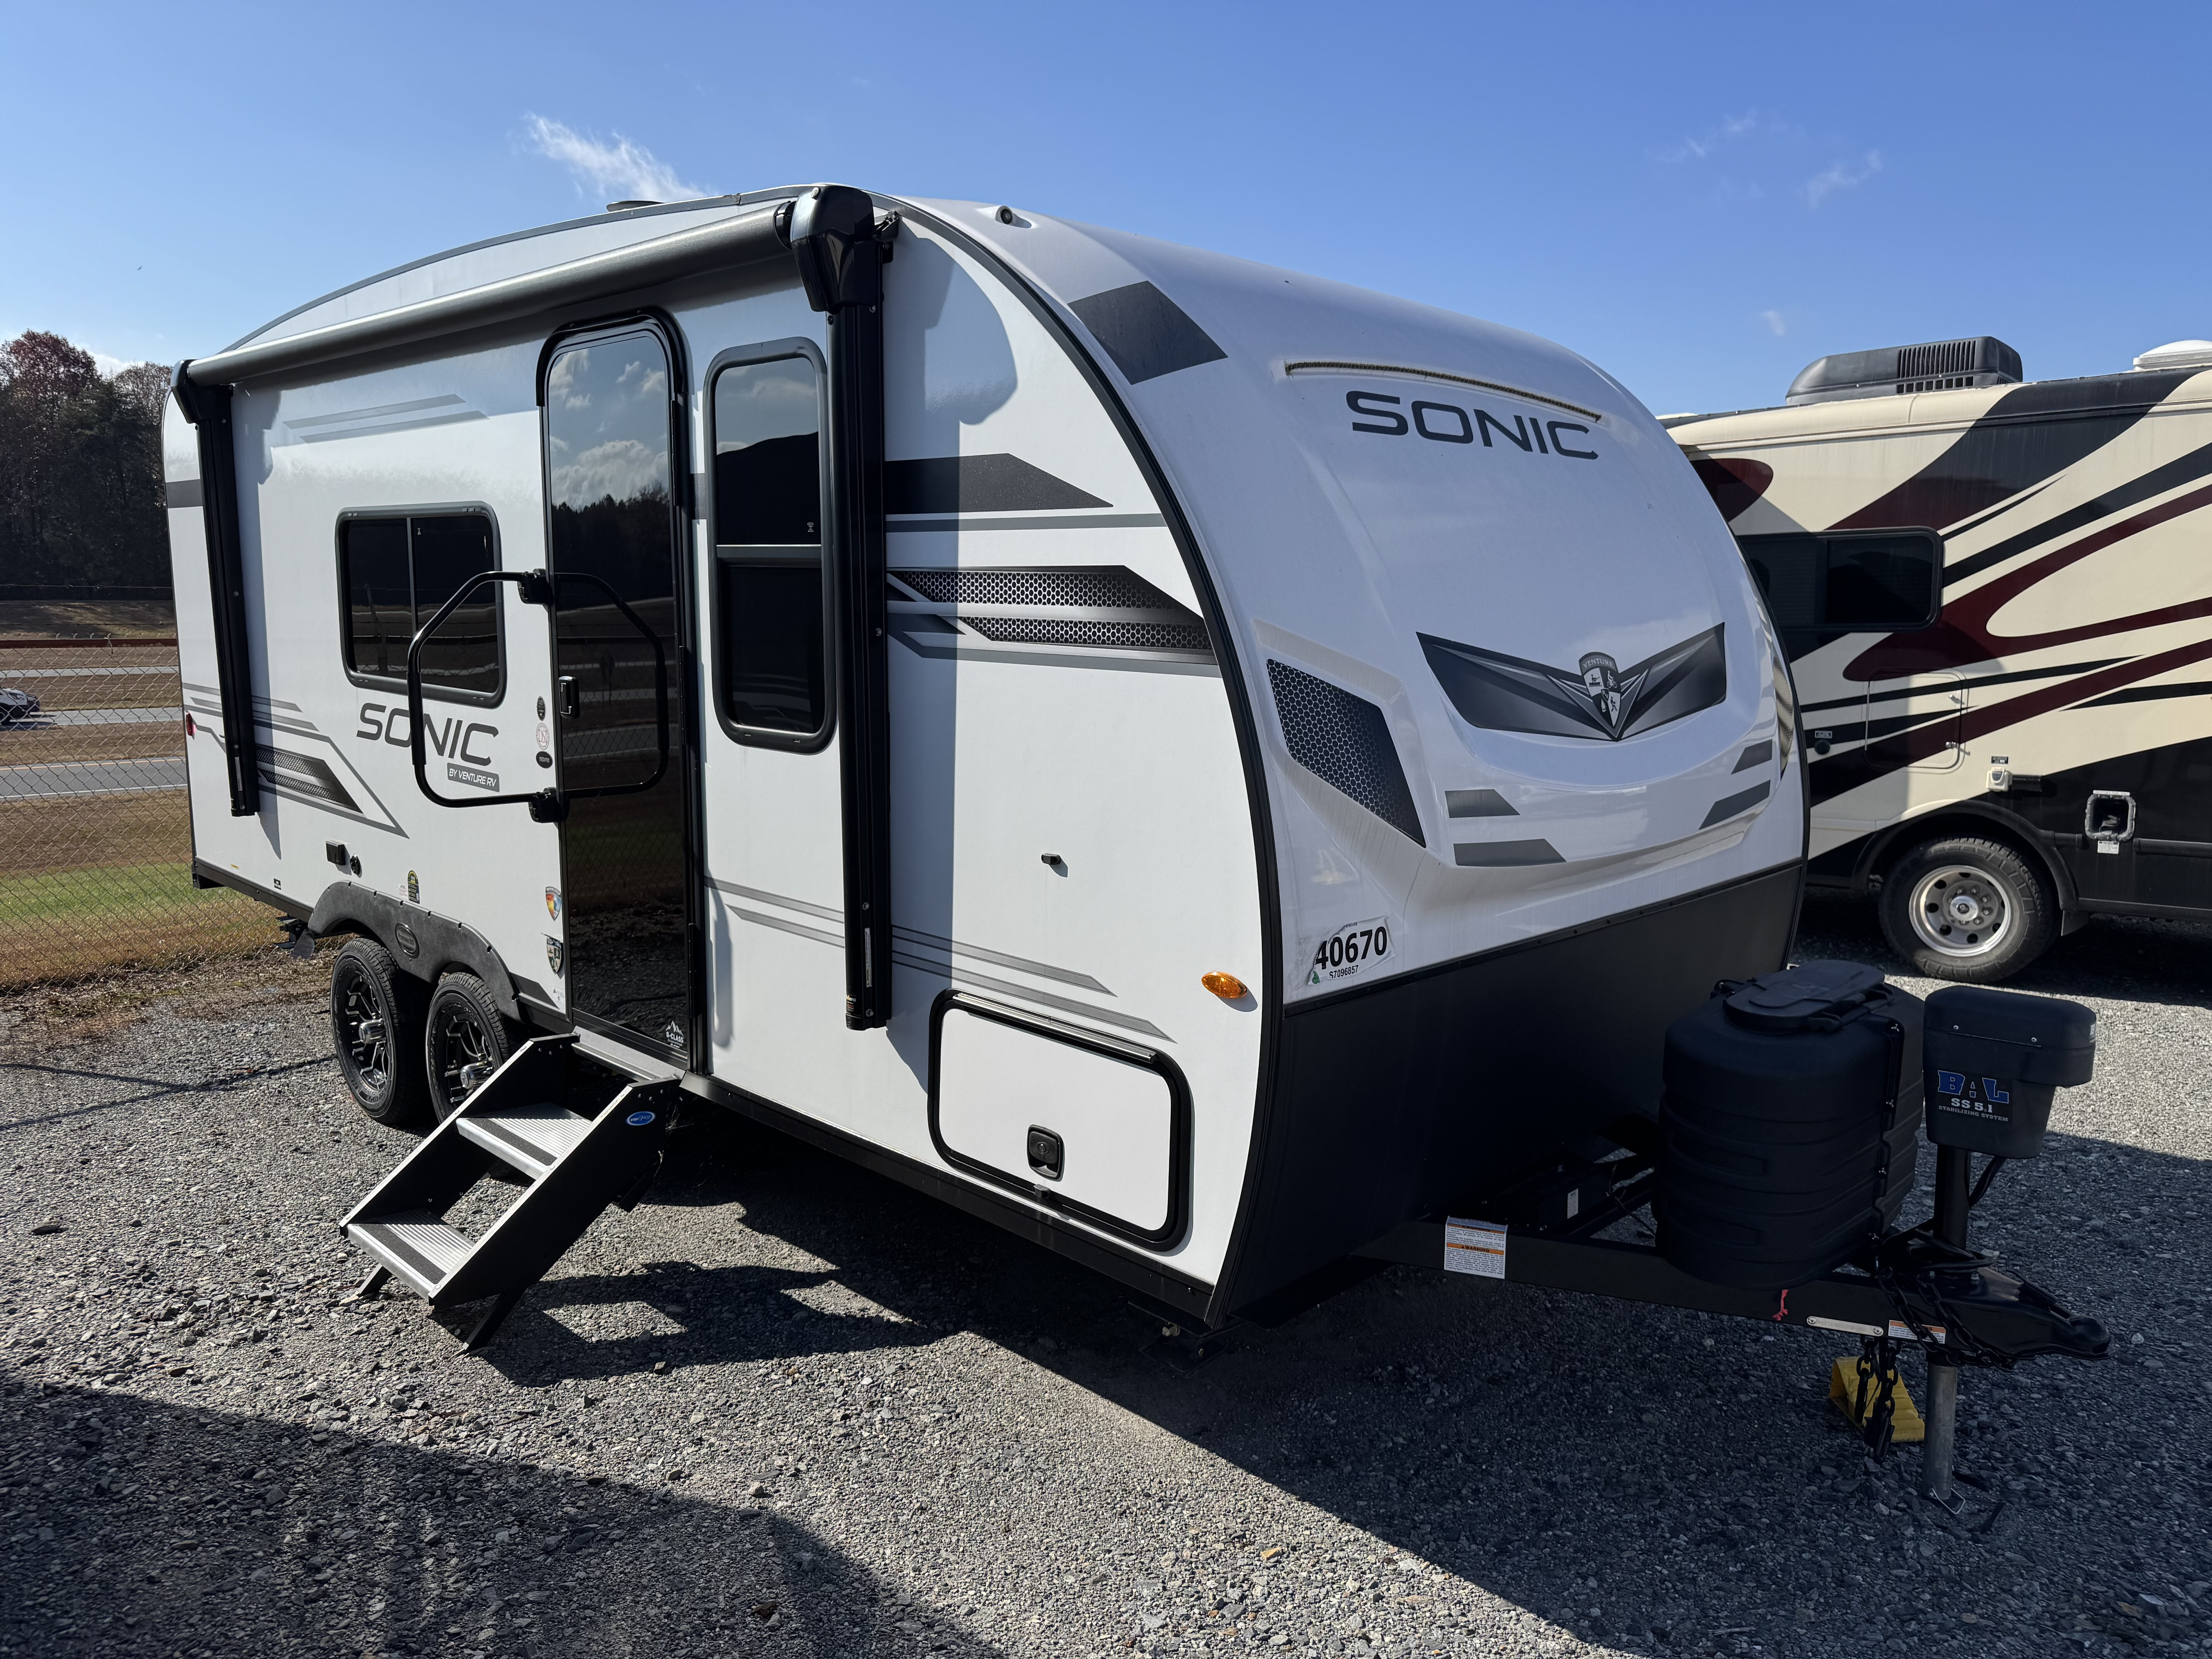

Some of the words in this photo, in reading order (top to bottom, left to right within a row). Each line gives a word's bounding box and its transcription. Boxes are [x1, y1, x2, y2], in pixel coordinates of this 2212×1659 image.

[1346, 390, 1599, 460] SONIC
[1583, 658, 1614, 669] VENTURE
[356, 702, 499, 766] SONIC
[449, 768, 458, 777] BY
[459, 770, 486, 785] VENTURE
[486, 777, 497, 787] RV
[1315, 926, 1387, 970] 40670
[1329, 965, 1358, 979] S7096857
[1938, 1070, 2009, 1104] BAL
[1938, 1105, 1980, 1117] STABILIZING
[1981, 1113, 2008, 1122] SYSTEM
[1951, 1098, 1971, 1109] SS
[1974, 1102, 1993, 1113] 5.1
